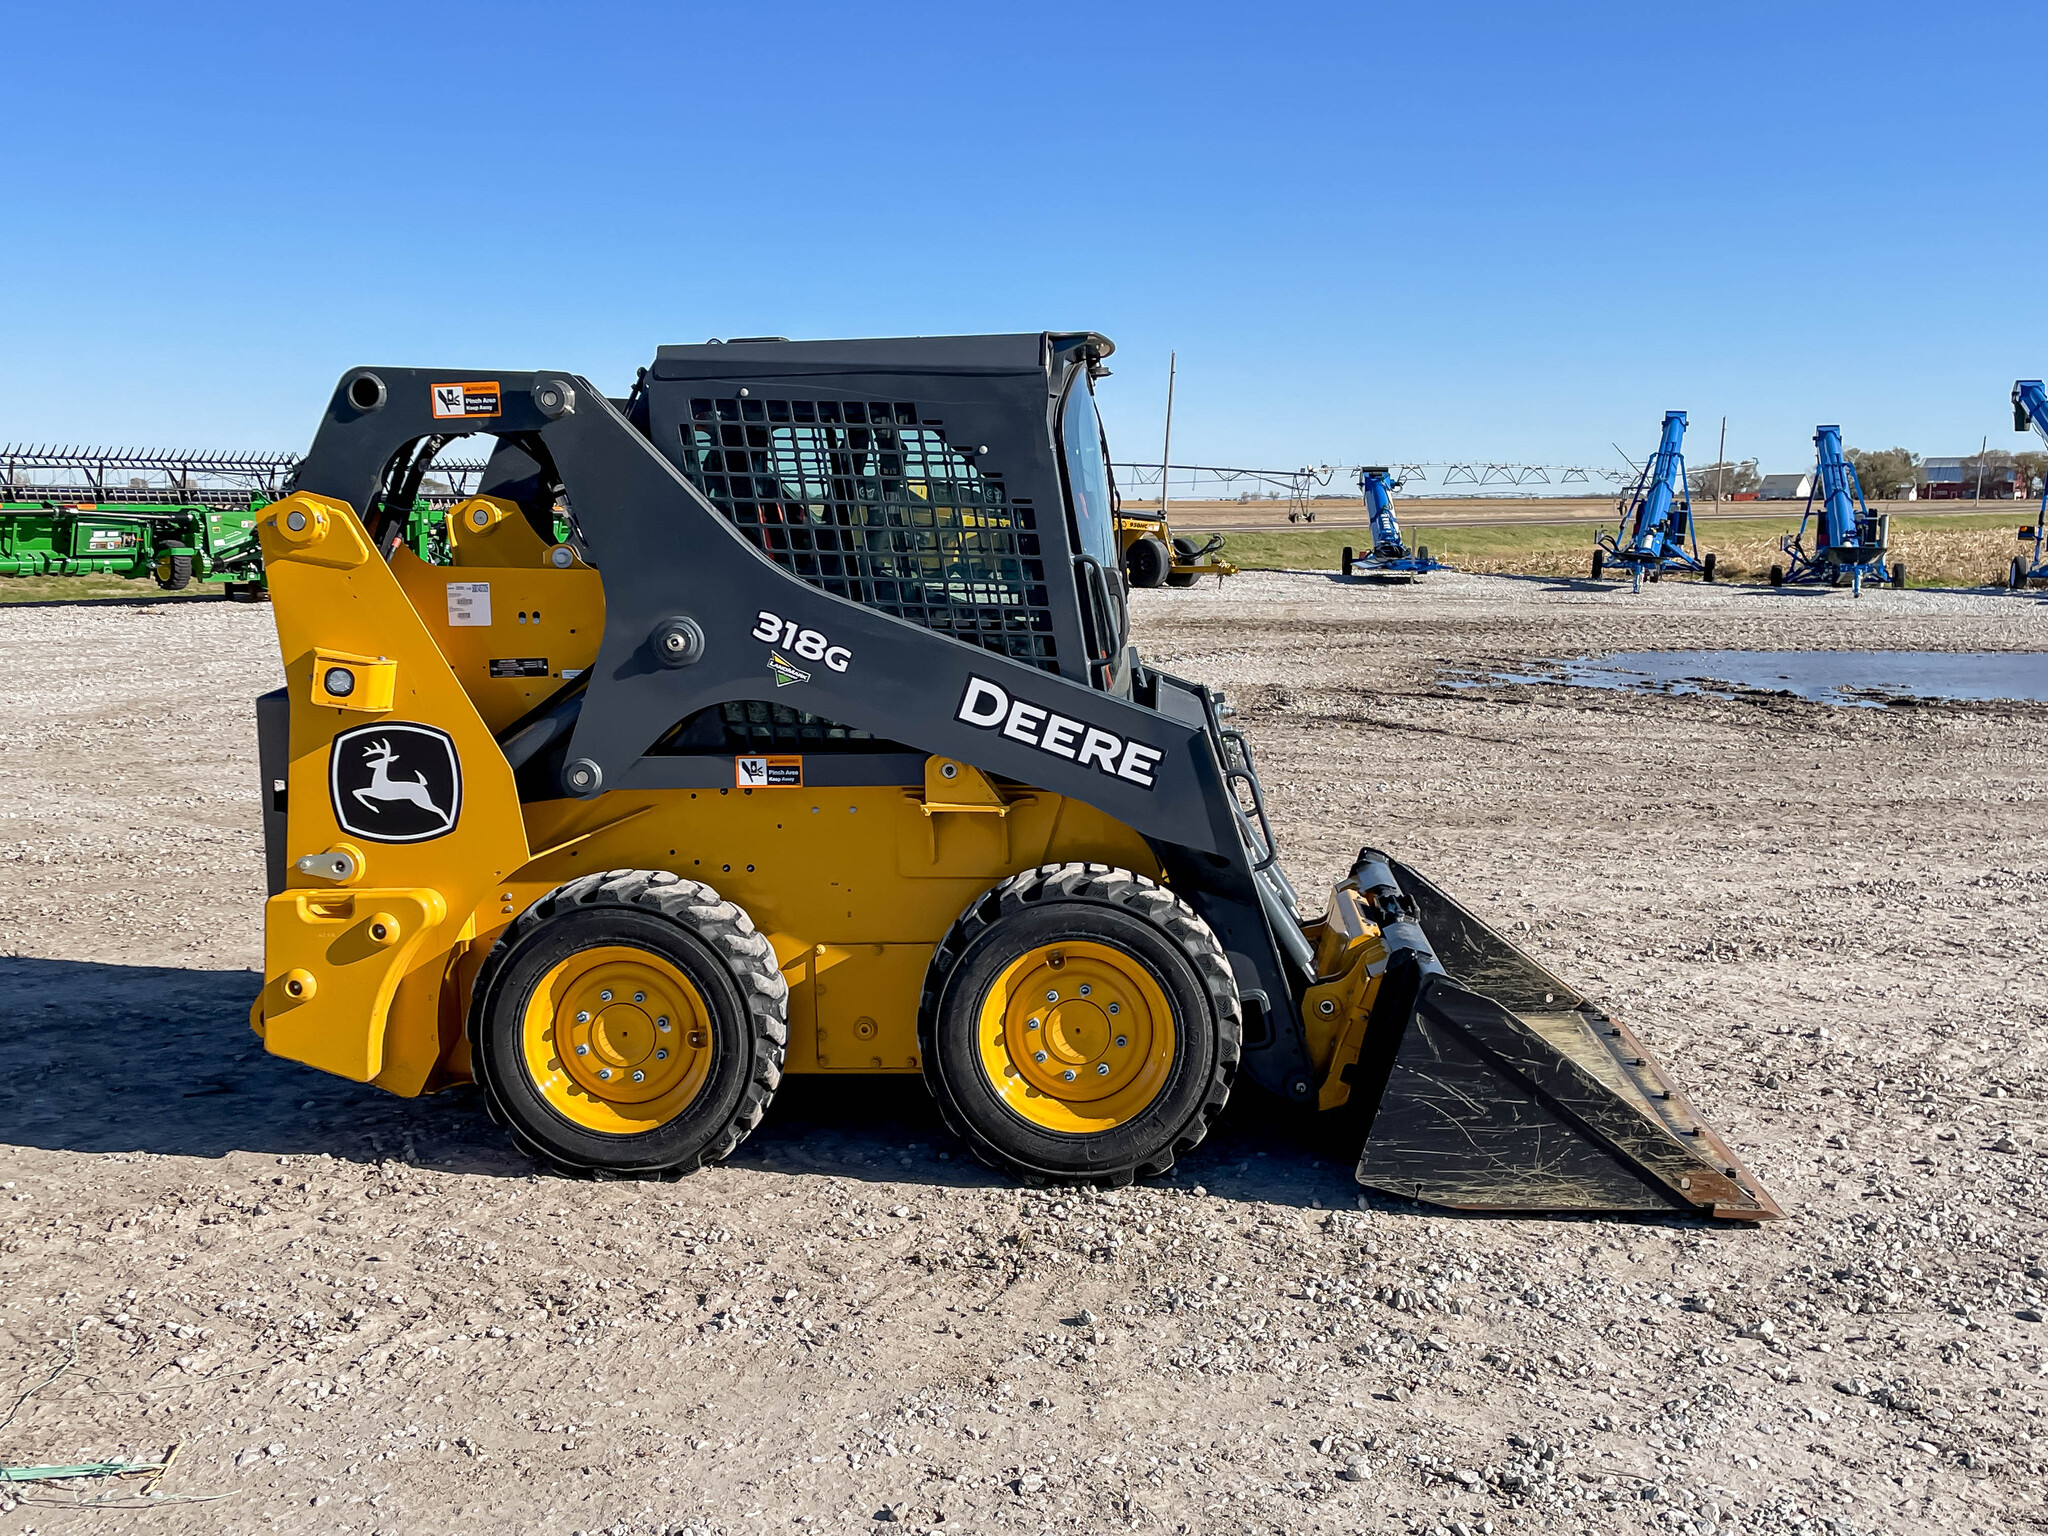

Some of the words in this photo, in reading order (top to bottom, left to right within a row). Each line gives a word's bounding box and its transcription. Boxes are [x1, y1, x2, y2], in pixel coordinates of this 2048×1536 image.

[752, 611, 852, 673] 318G
[769, 661, 808, 680] LANDMARK
[958, 676, 1162, 787] DEERE
